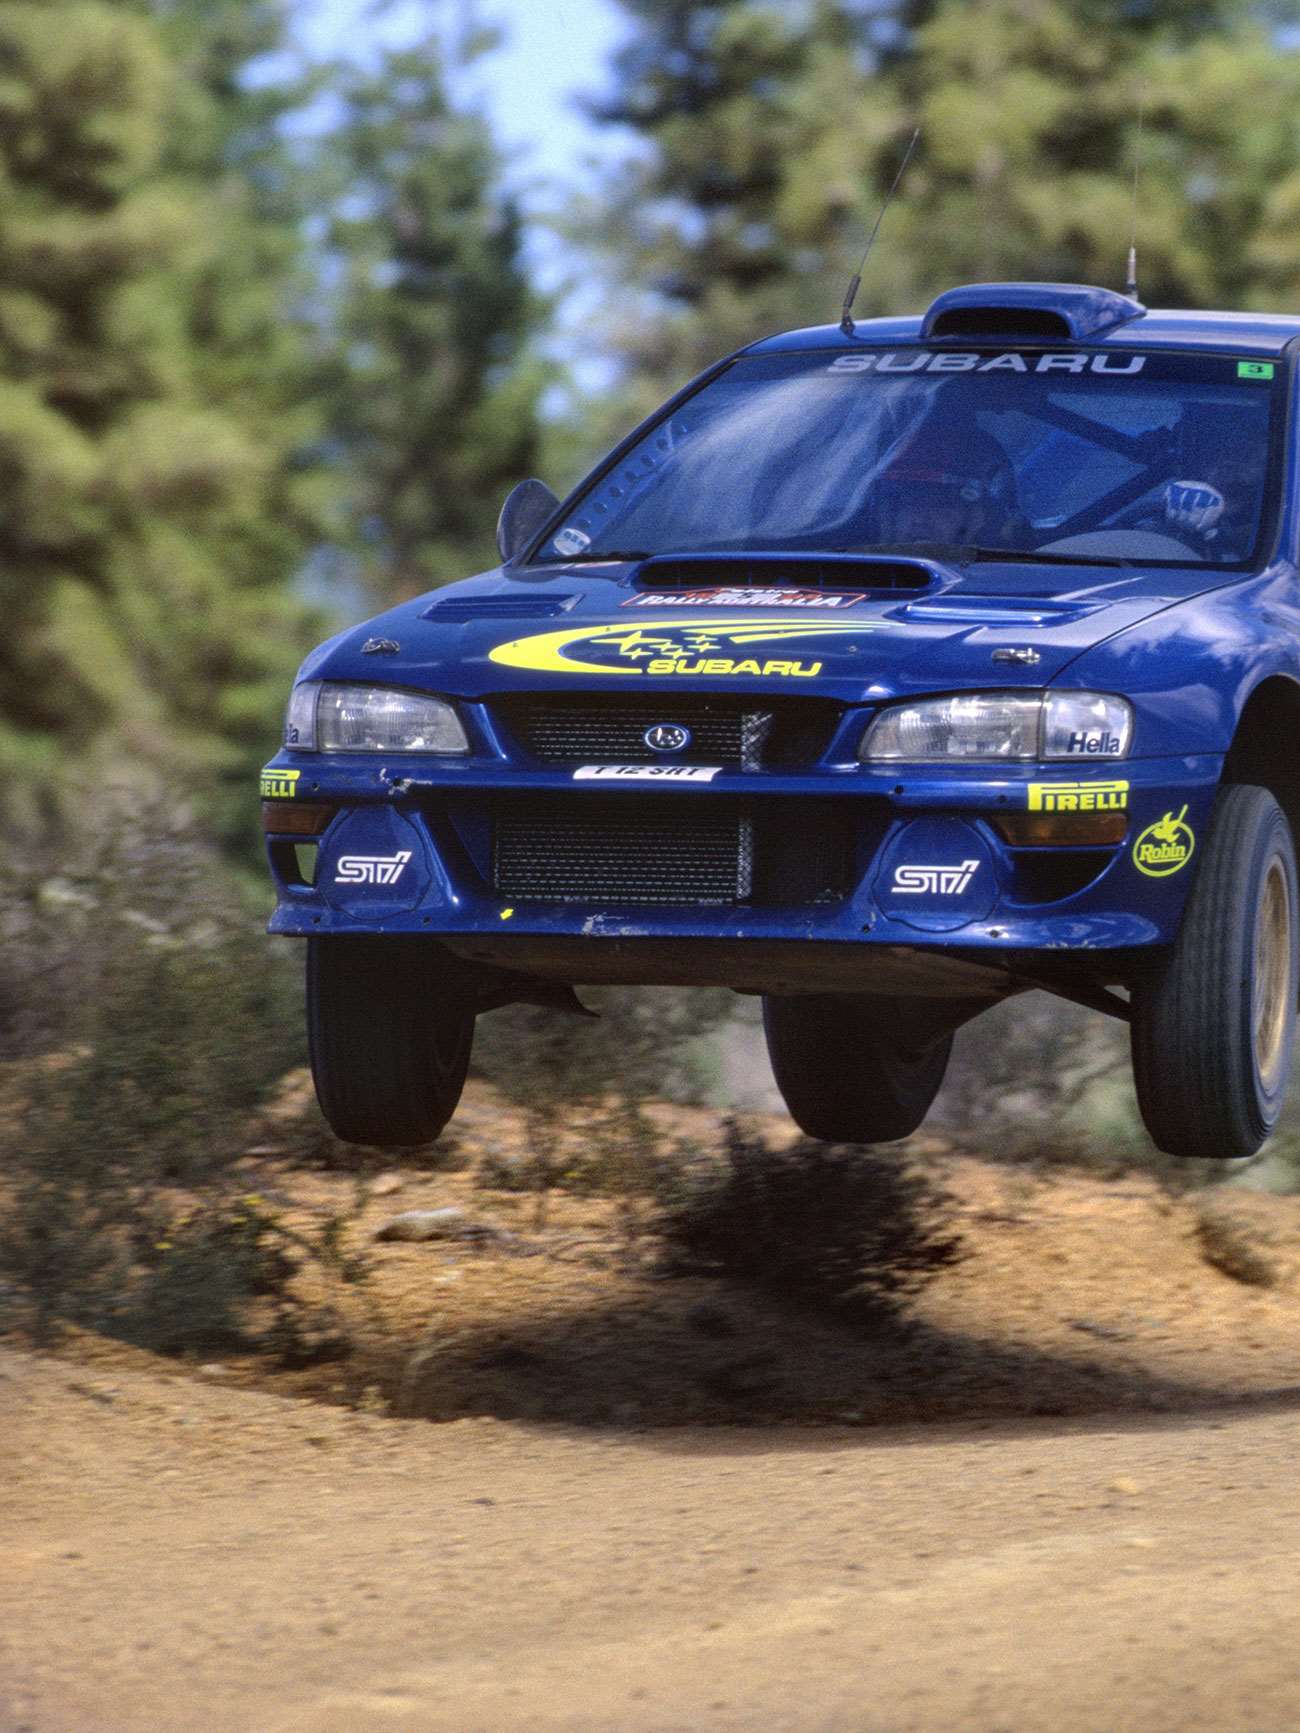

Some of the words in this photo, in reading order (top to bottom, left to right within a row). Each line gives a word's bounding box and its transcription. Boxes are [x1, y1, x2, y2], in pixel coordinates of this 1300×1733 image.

[826, 353, 1146, 374] SUBARU
[646, 658, 822, 677] SUBARU
[1067, 732, 1120, 753] Hella
[1028, 780, 1129, 811] PIRELLI
[1139, 843, 1186, 864] Robin
